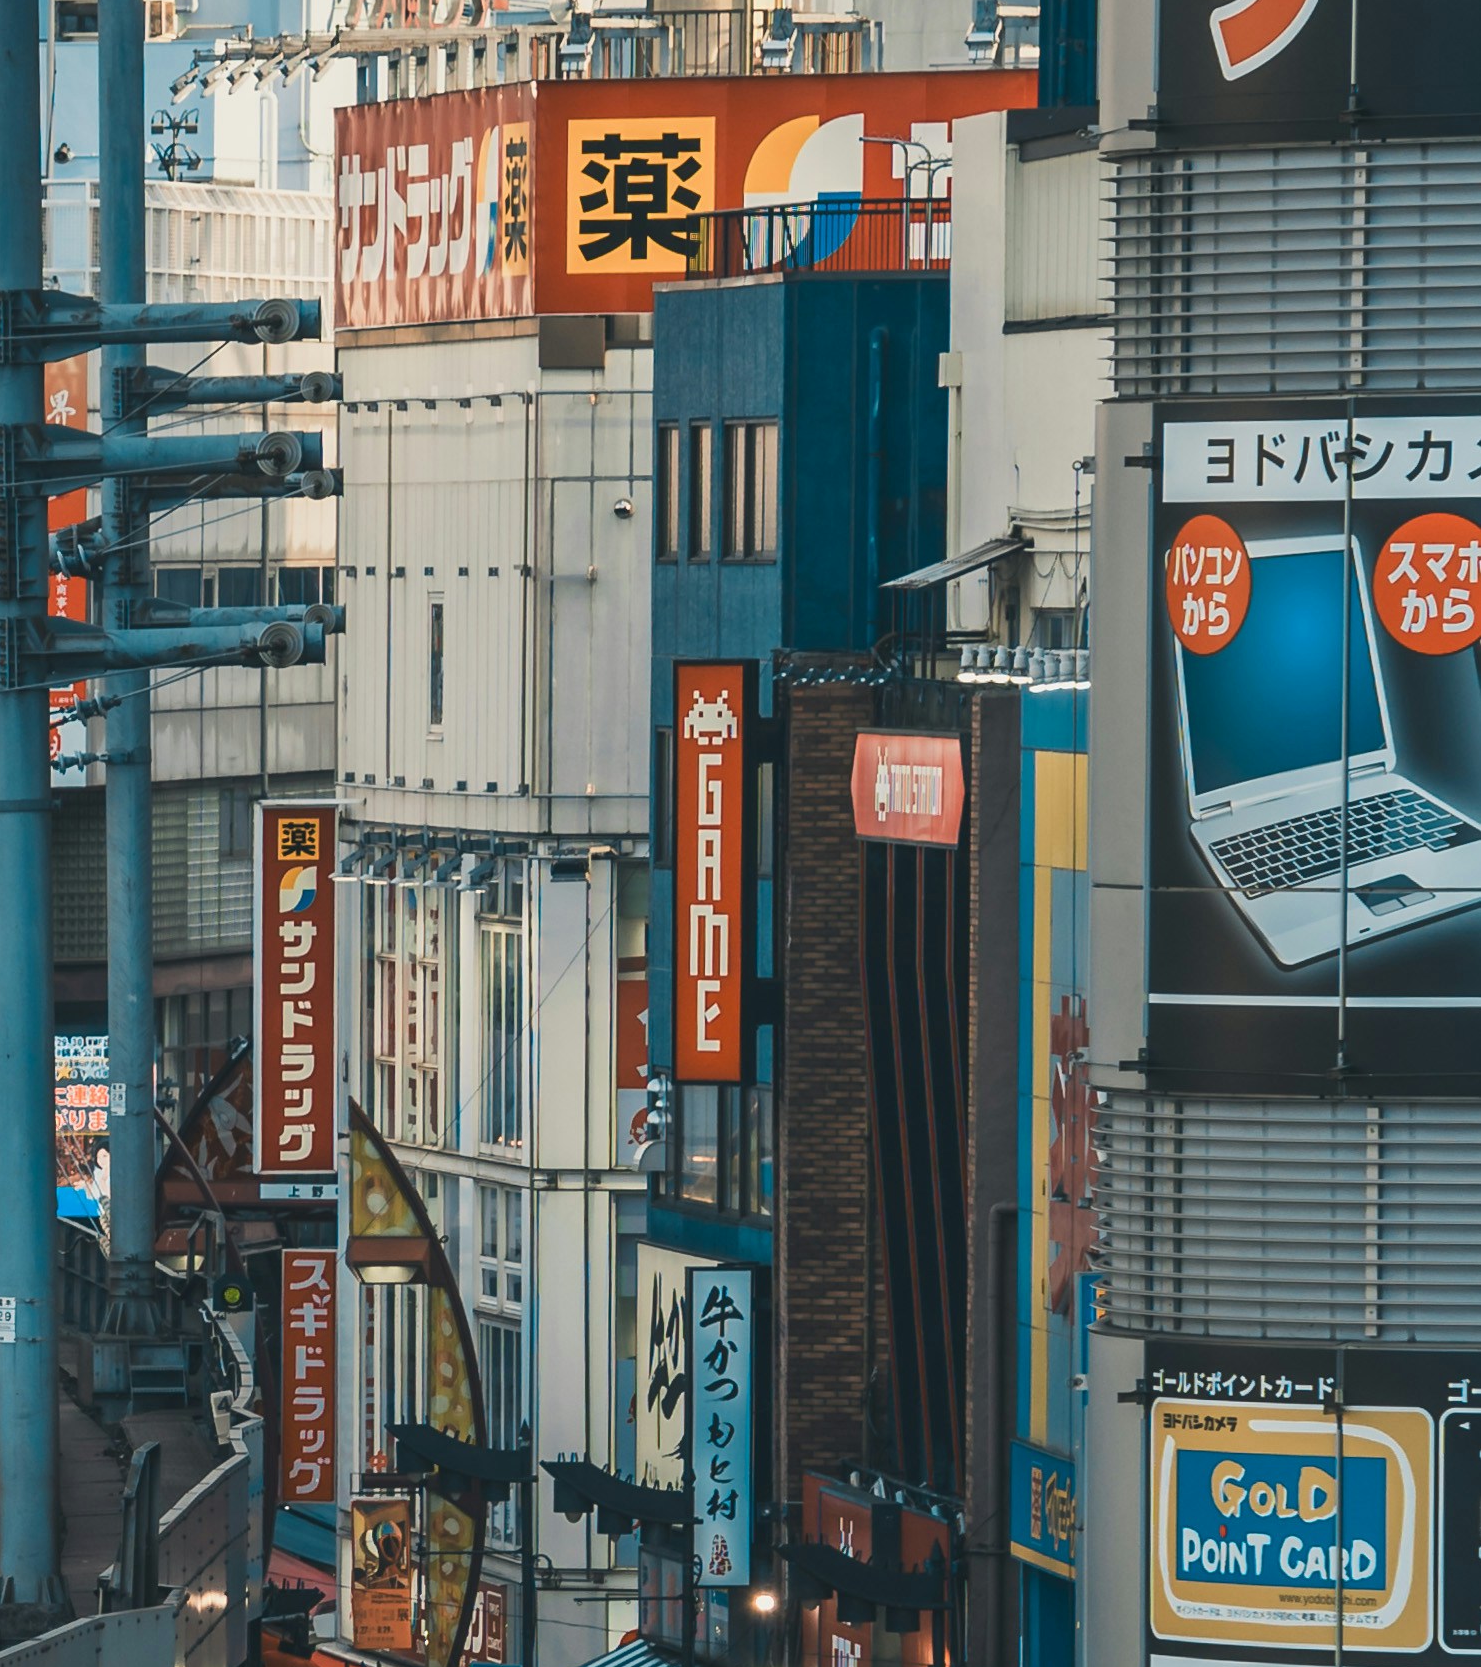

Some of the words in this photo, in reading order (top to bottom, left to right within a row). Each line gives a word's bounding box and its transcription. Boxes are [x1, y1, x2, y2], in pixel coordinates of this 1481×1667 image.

[339, 133, 475, 284] サンドラッグ
[503, 135, 528, 263] 薬
[577, 132, 703, 261] 薬
[1172, 543, 1242, 586] パソコン
[1387, 540, 1481, 584] スマホ
[1181, 598, 1231, 637] から
[1400, 587, 1476, 635] から
[280, 820, 319, 858] 薬
[689, 753, 730, 1052] GAME
[279, 919, 317, 1162] サンドラッグ
[289, 1258, 331, 1496] スギドラッグ
[1151, 1369, 1335, 1401] ゴールドポイントカード
[1162, 1412, 1238, 1433] ヨドバシカメラ
[1209, 1458, 1338, 1523] GOLD
[1181, 1521, 1272, 1579] POINT
[1278, 1535, 1378, 1583] CARD
[1278, 1591, 1378, 1608] www.yodobashi.com
